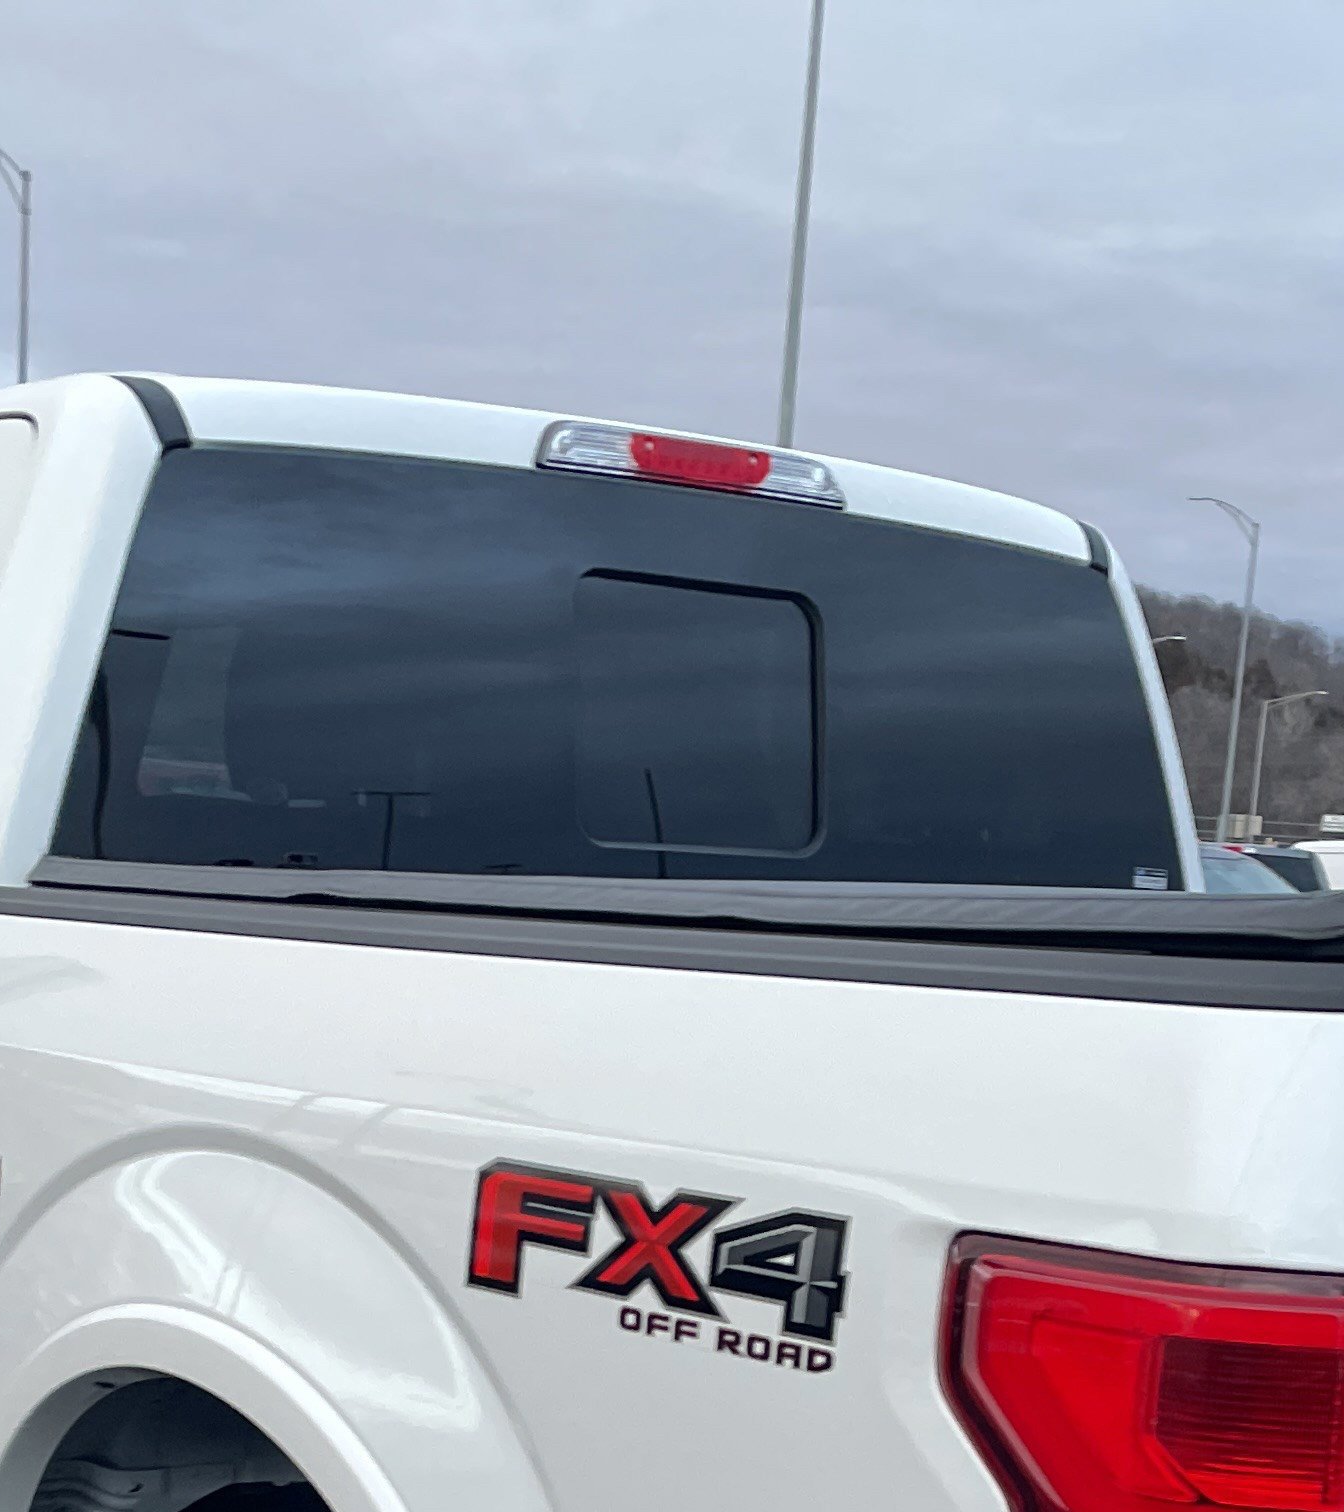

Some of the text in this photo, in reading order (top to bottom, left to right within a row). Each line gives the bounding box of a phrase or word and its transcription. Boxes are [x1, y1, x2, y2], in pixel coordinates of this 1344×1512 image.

[465, 1156, 853, 1346] FX4
[619, 1305, 834, 1374] OFF ROAD
